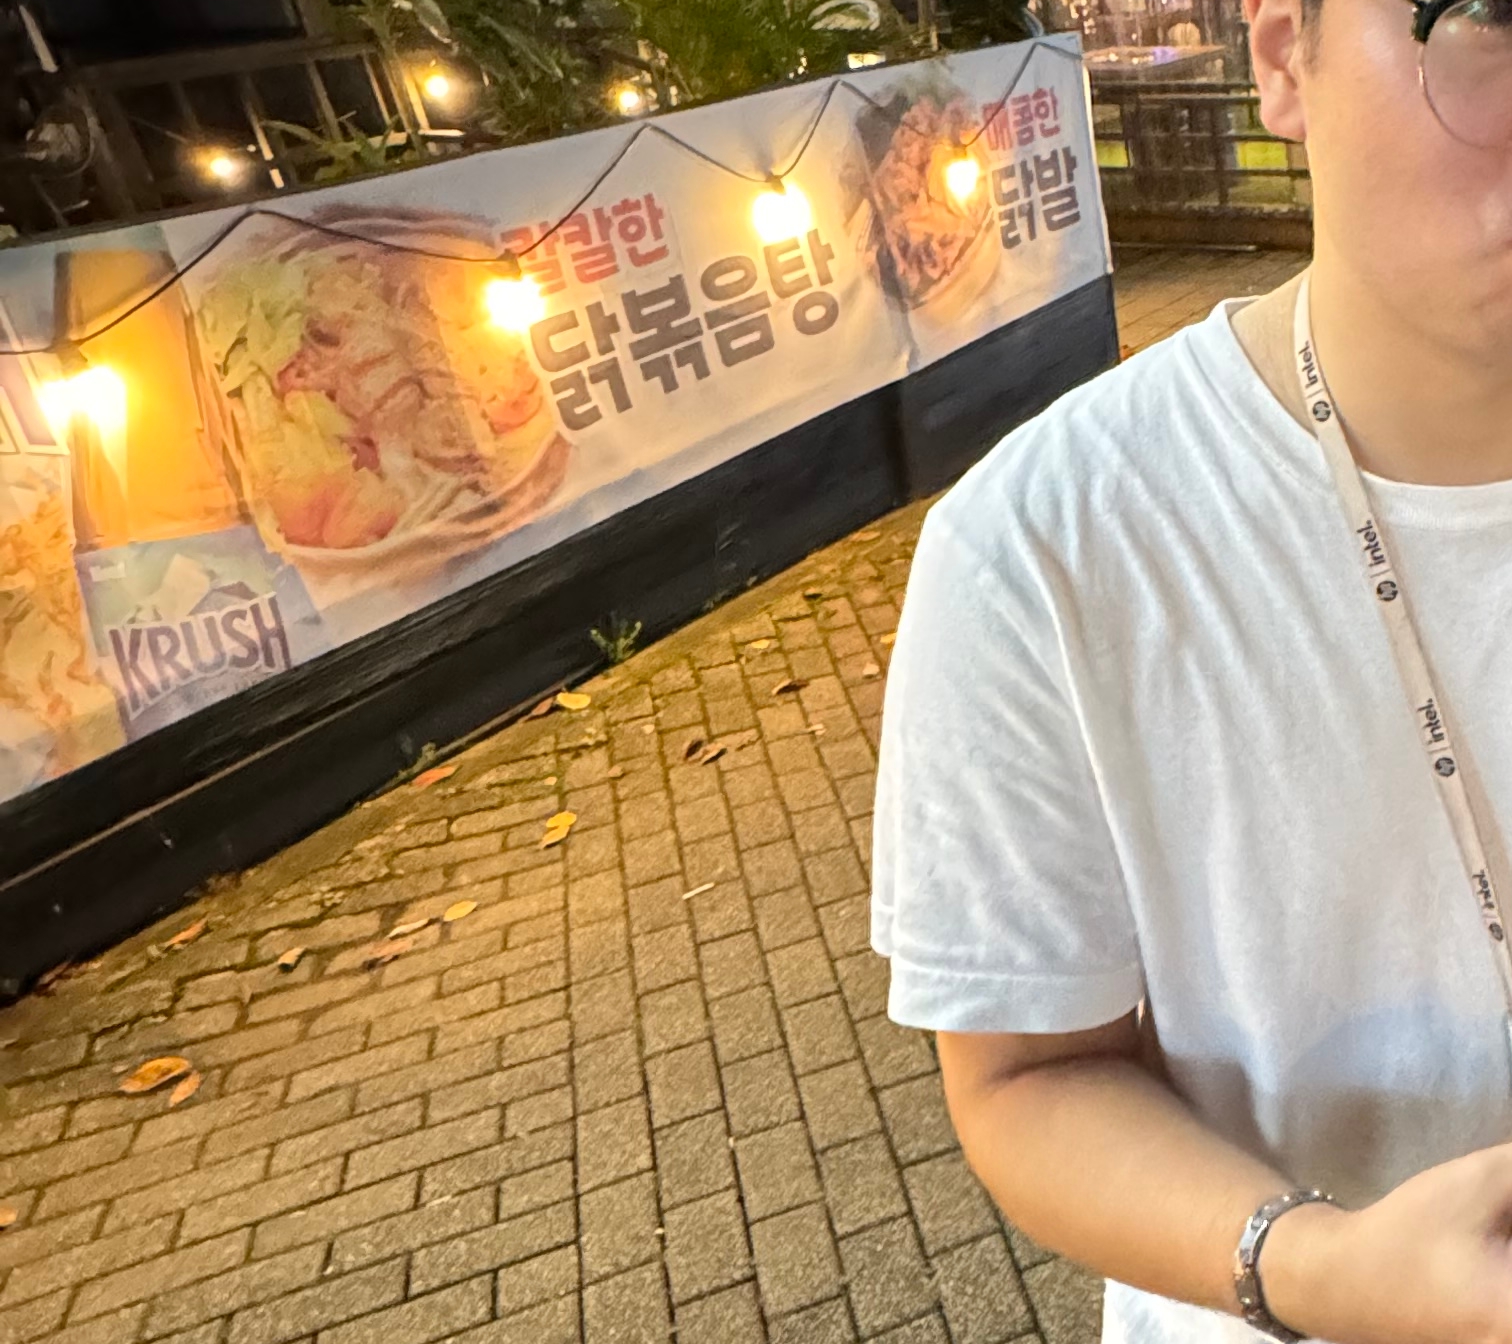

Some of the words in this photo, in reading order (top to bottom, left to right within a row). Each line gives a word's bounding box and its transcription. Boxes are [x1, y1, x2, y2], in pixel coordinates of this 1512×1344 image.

[982, 86, 1061, 153] 매콤한
[991, 146, 1083, 248] 닭발
[529, 228, 840, 432] 닭볶음탕
[109, 593, 292, 714] KRUSH
